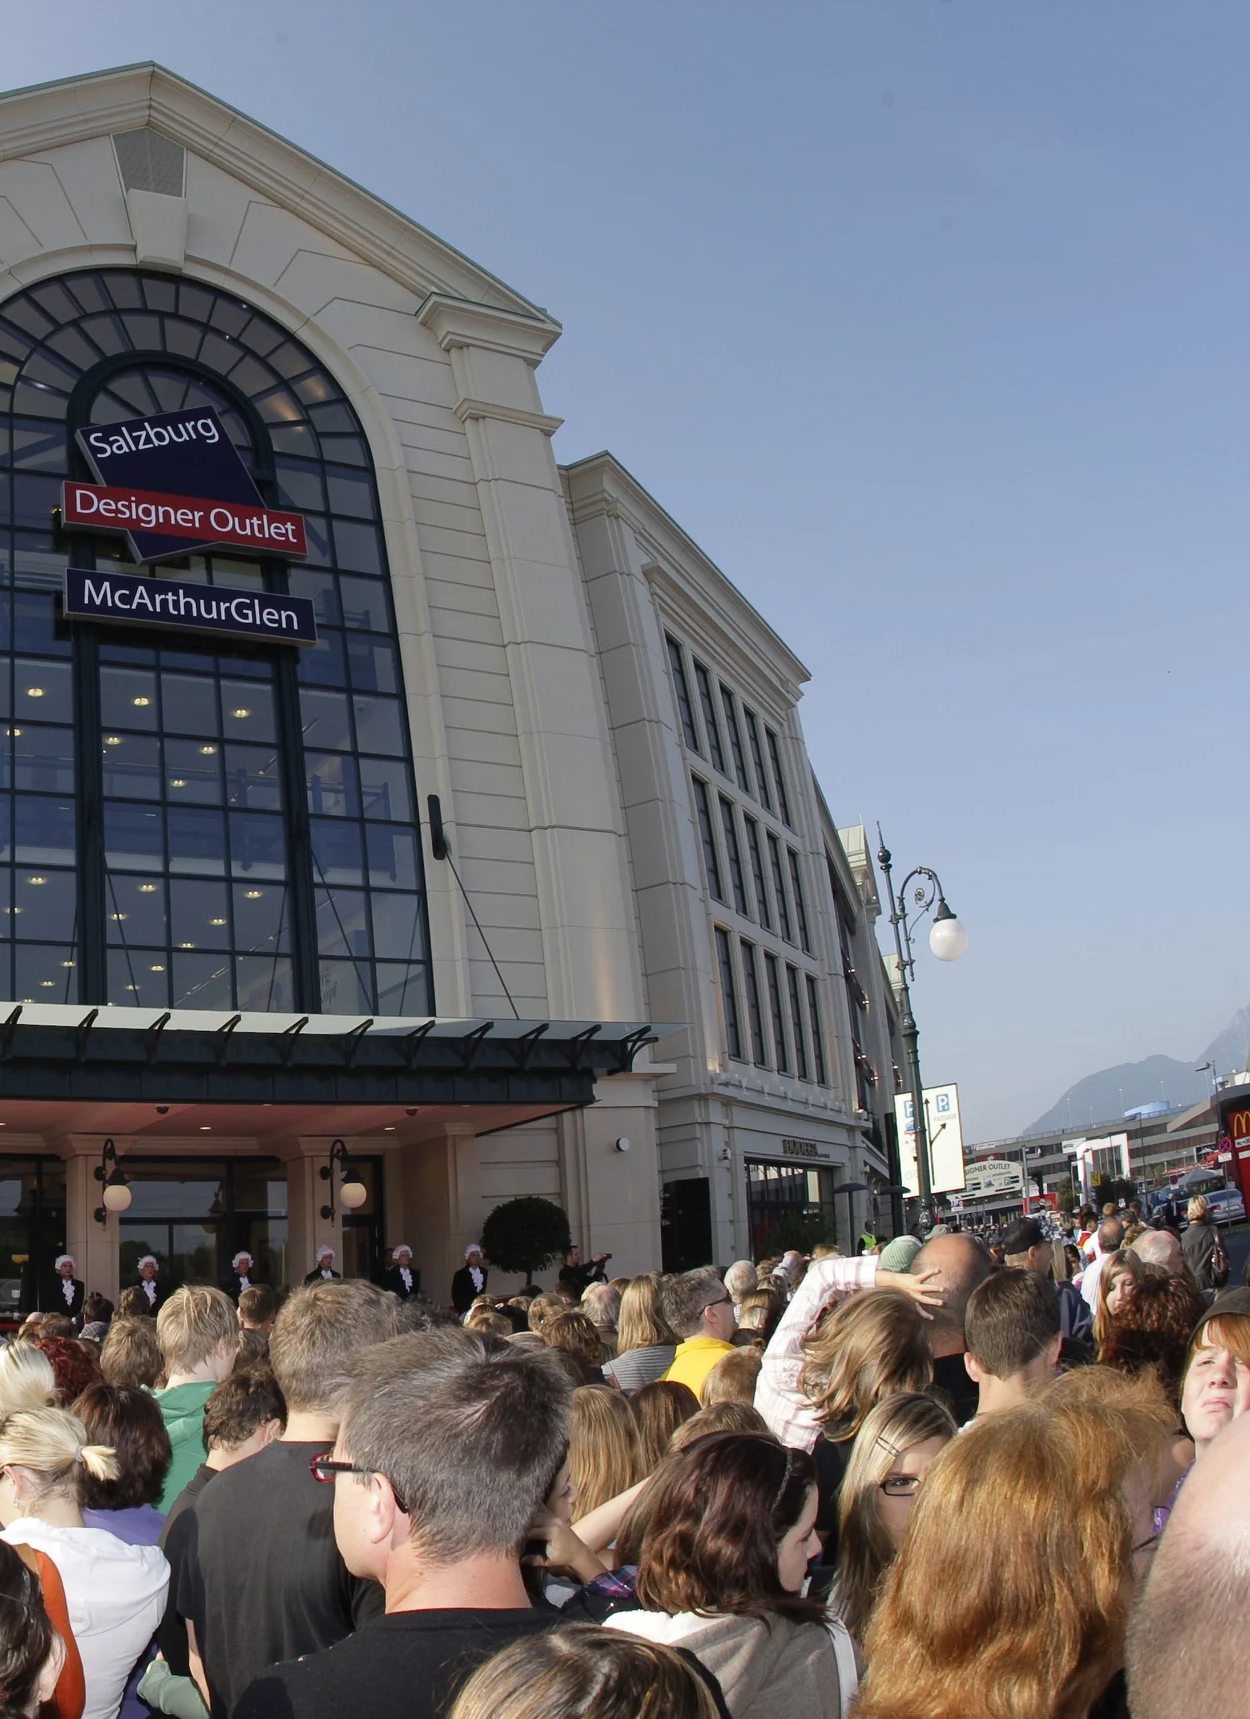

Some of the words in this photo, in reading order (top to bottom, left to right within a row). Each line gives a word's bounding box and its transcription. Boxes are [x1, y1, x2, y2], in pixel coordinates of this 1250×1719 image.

[90, 417, 219, 458] Salzburg
[75, 489, 203, 527] Designer
[210, 508, 297, 542] Outlet
[83, 579, 298, 630] McArthurGlen
[988, 1163, 1010, 1171] OUTLET
